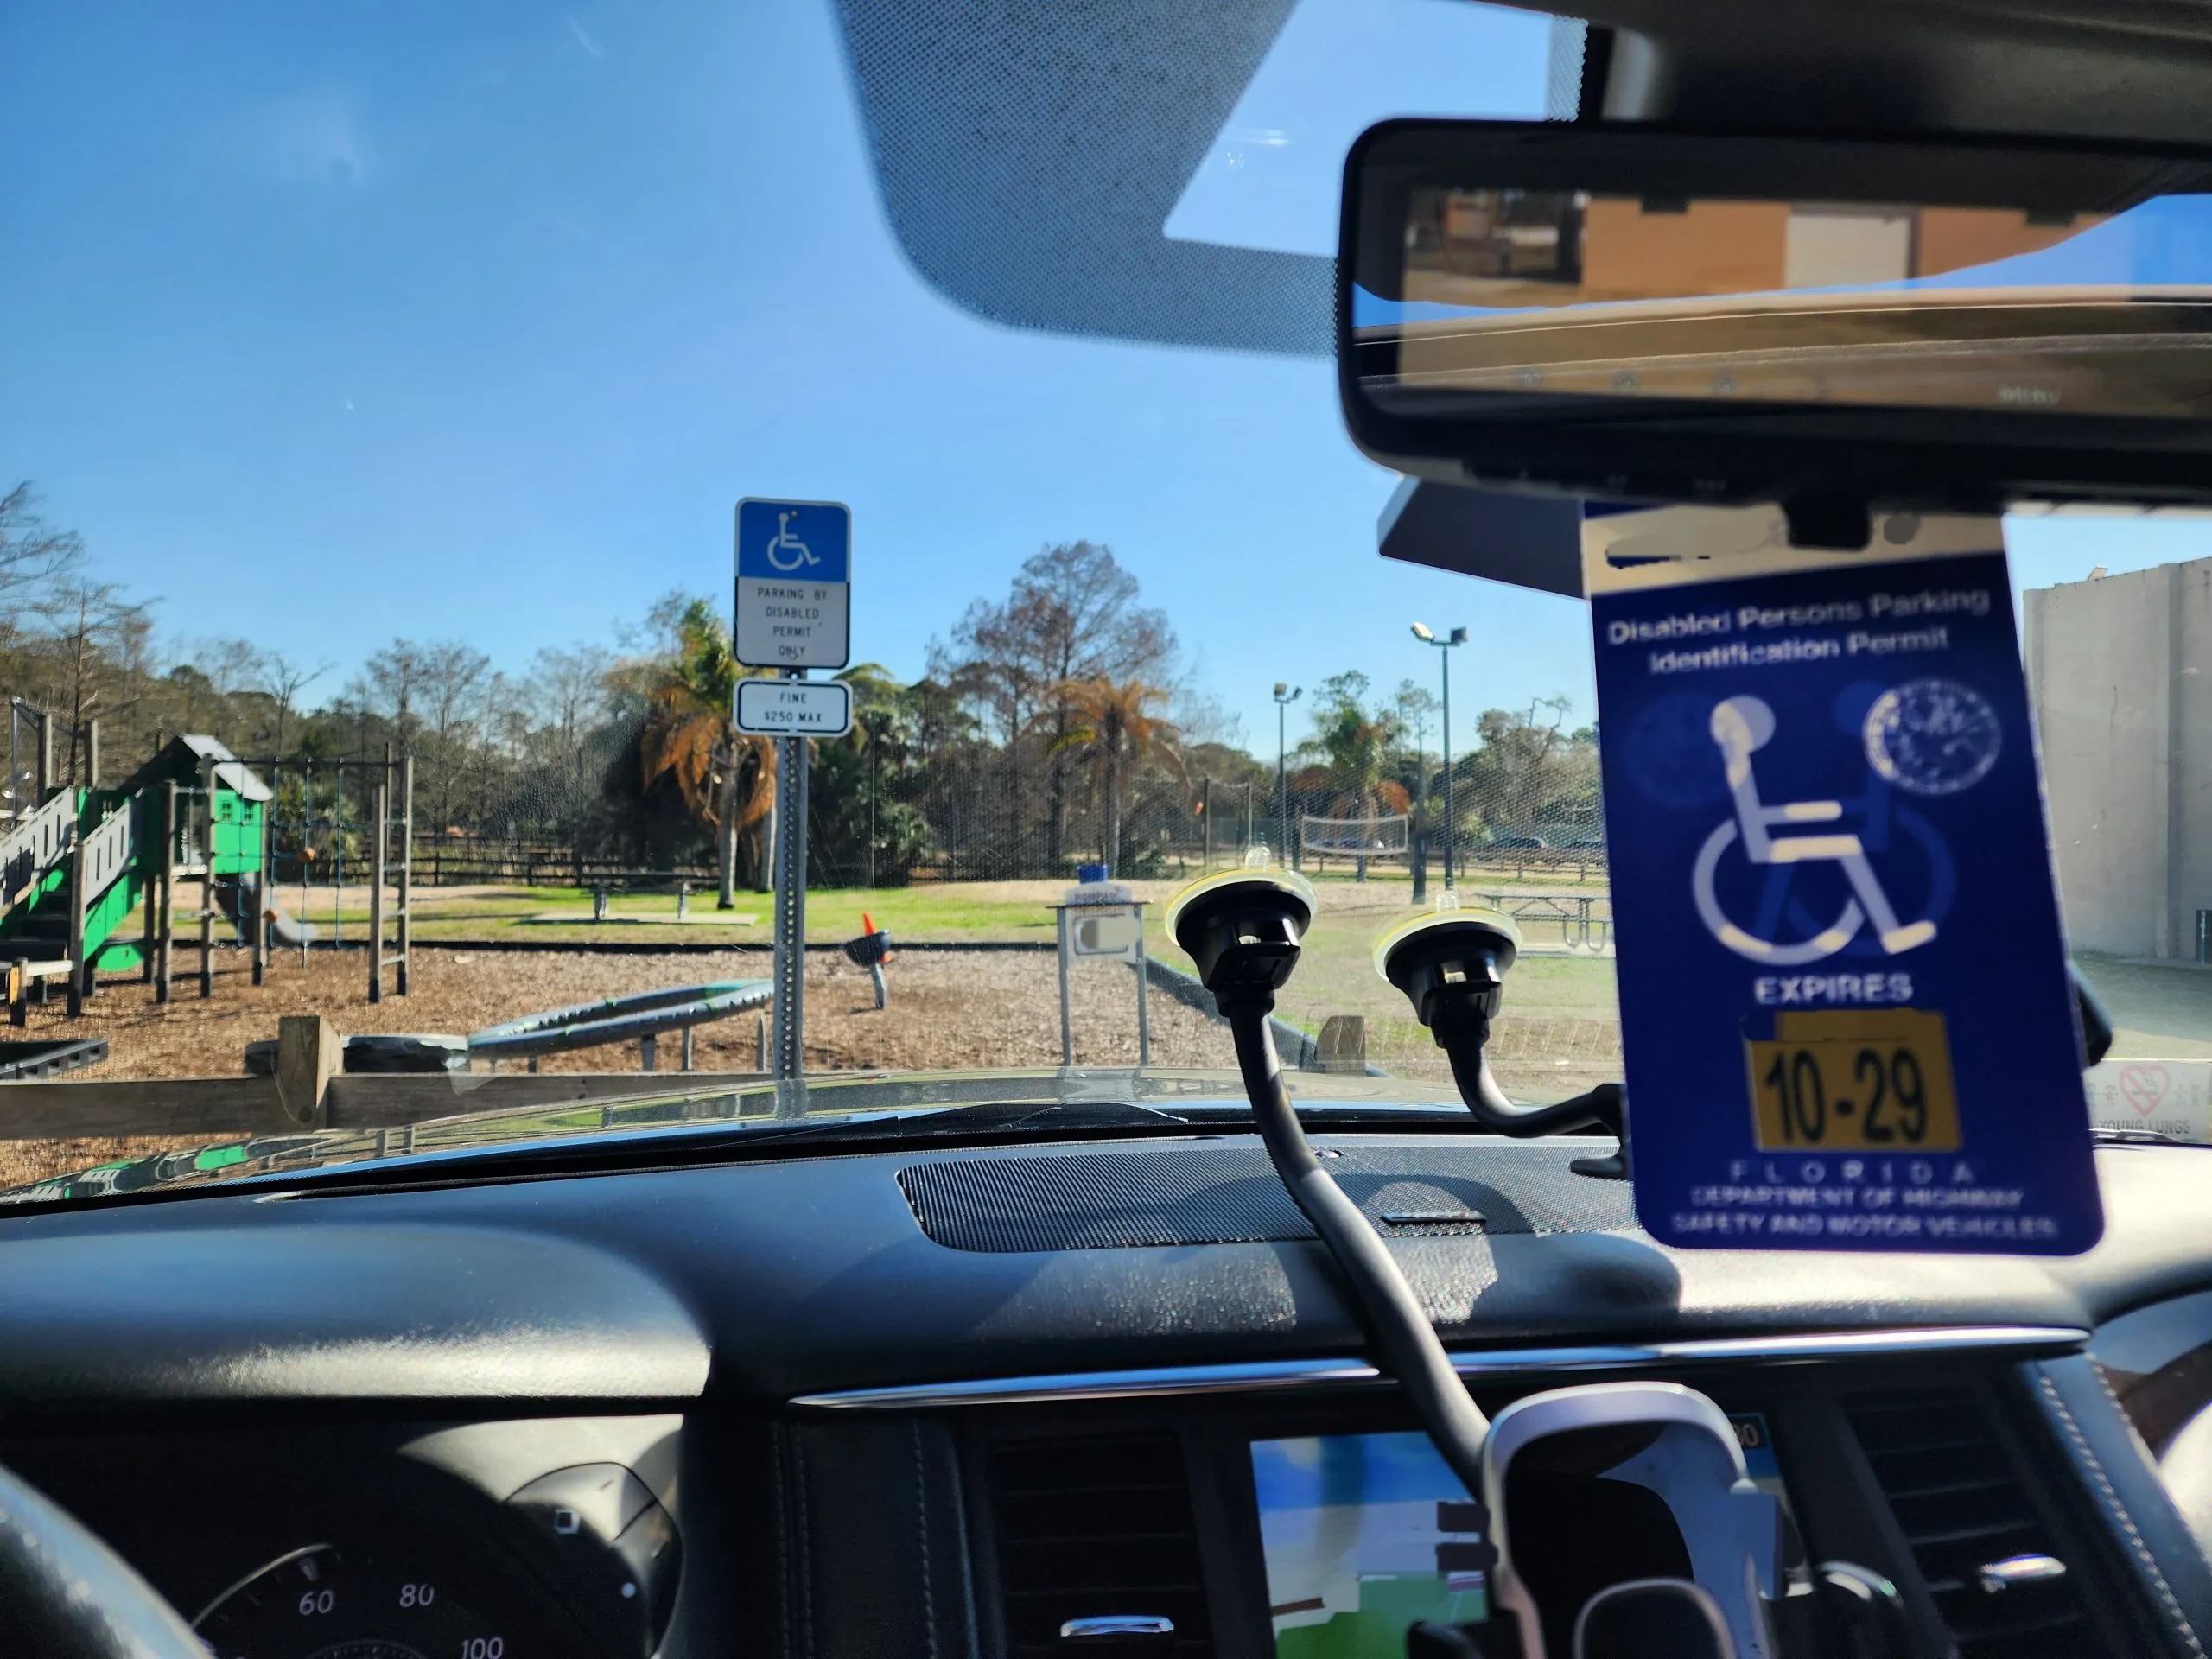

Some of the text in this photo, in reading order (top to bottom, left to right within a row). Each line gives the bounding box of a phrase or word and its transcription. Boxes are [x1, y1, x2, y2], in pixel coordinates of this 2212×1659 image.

[757, 587, 828, 601] PARKING BY
[766, 607, 820, 620] DISABLED
[1606, 588, 1989, 645] Disabled Persons Parking
[772, 626, 811, 639] PERMIT
[778, 645, 806, 658] ONLY
[1649, 626, 1950, 674] Identification Permit
[779, 692, 808, 704] FINE
[764, 710, 823, 723] $250 MAX
[1753, 972, 1915, 1005] EXPIRES
[2148, 1119, 2192, 1135] LUNGS
[1689, 1185, 2024, 1211] DEPARTMENT OF HIGHWAY
[1670, 1211, 2060, 1240] SAFETY AND MOTOR VEHICLES
[299, 1590, 334, 1615] 60
[399, 1583, 435, 1608] 80
[461, 1637, 505, 1659] 100
